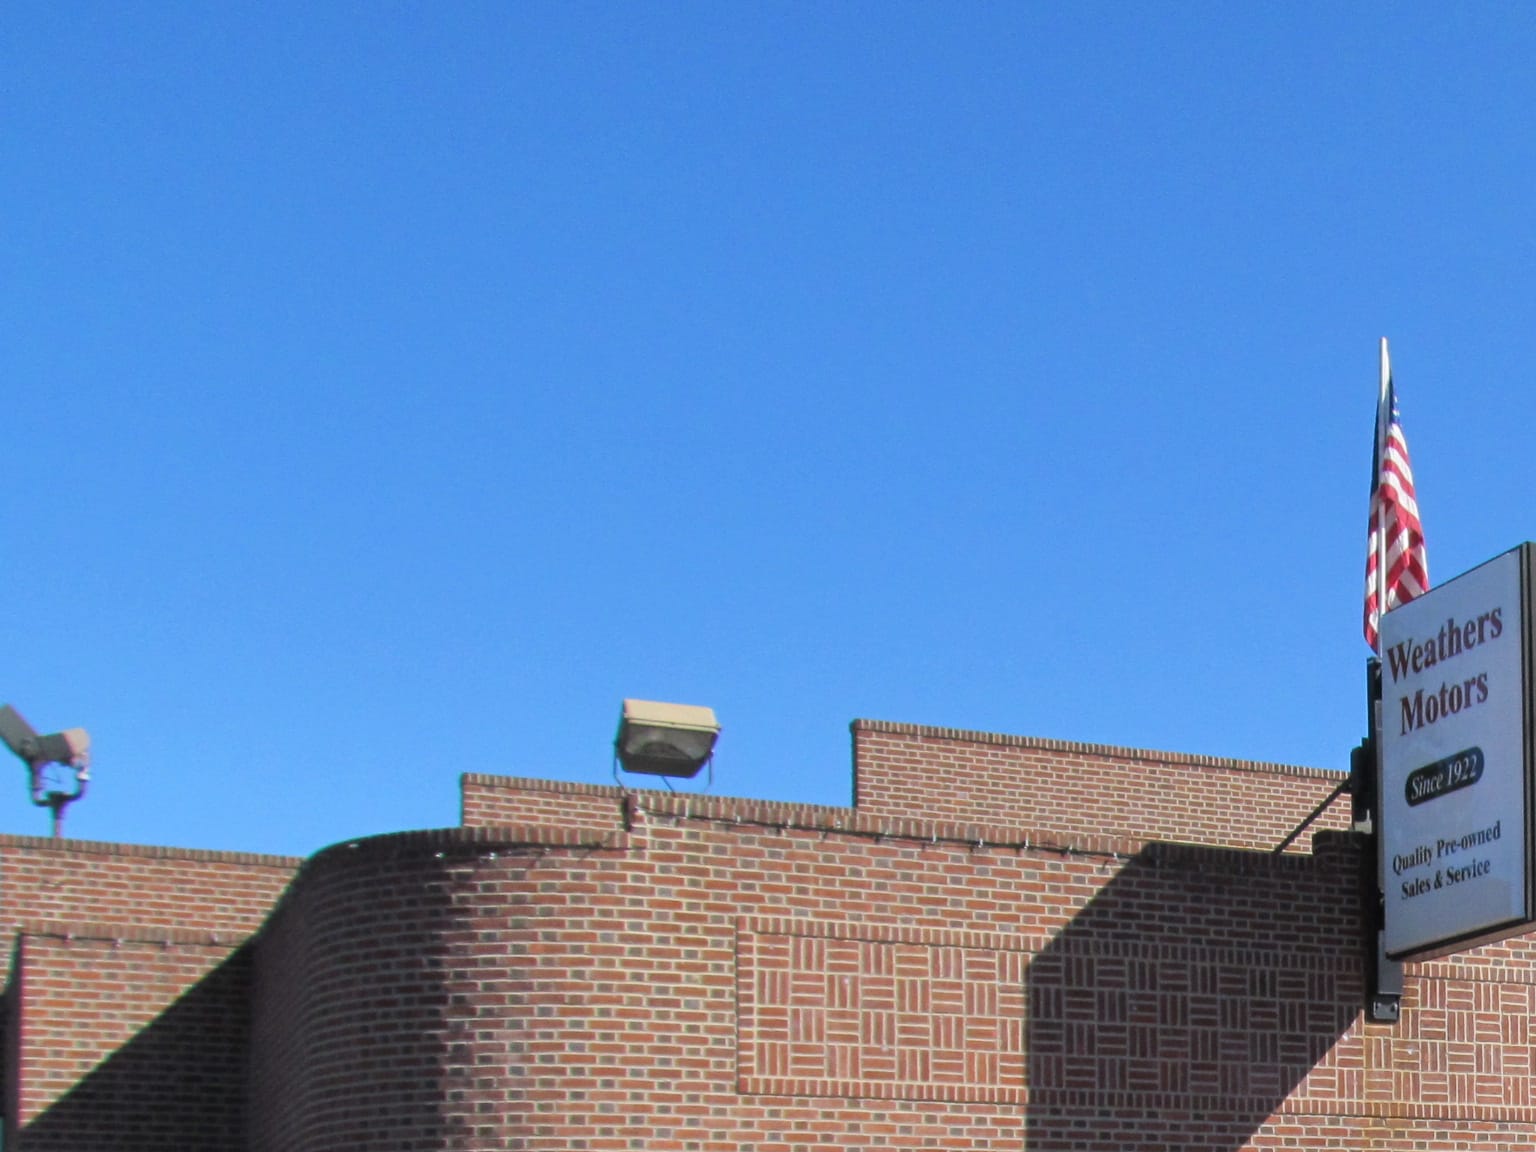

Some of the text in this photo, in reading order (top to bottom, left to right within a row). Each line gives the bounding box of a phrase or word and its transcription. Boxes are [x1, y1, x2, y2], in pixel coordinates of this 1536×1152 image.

[1387, 607, 1502, 684] Weathers
[1400, 670, 1489, 736] Motors
[1411, 754, 1478, 800] Since 1922
[1392, 820, 1501, 877] Quality Pre-owned
[1401, 857, 1491, 900] Sales & Service
